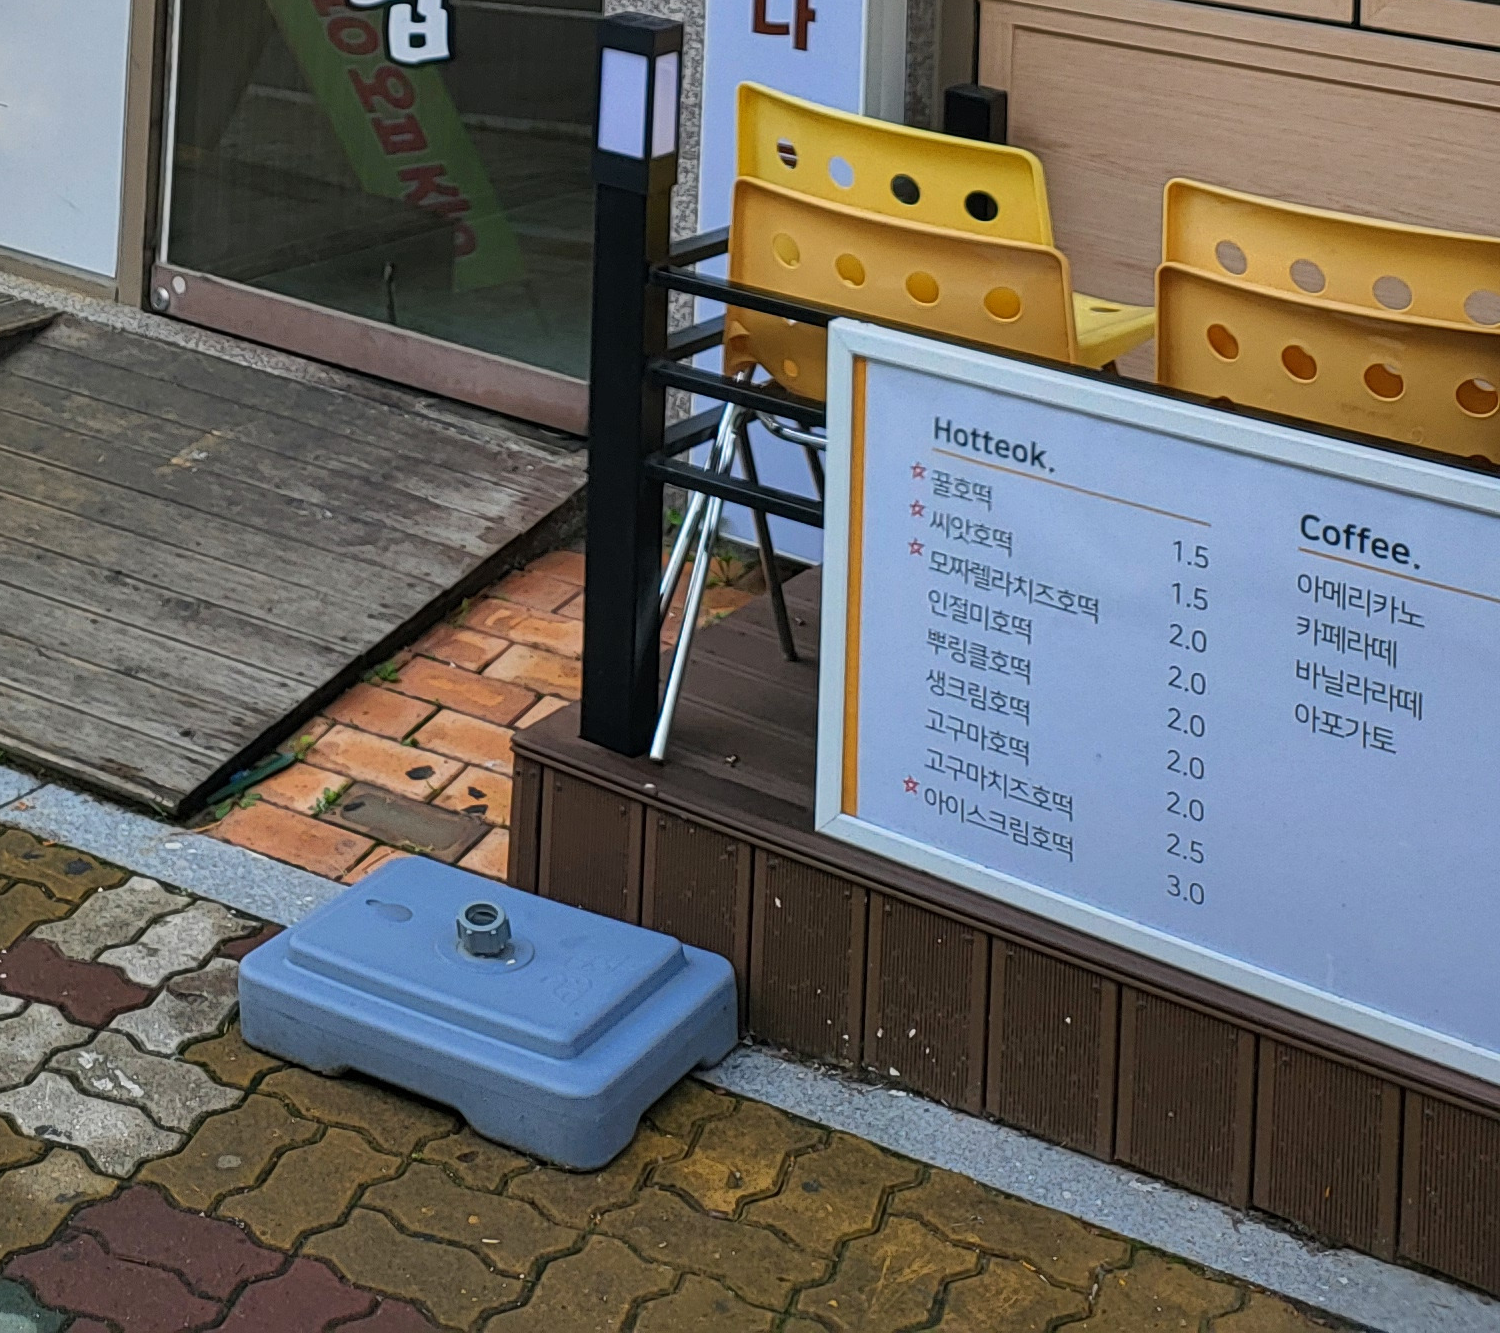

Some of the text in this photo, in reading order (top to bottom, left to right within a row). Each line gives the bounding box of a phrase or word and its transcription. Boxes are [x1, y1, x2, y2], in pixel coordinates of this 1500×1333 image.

[933, 415, 1057, 475] Hotteok.
[929, 509, 1210, 612] 씨앗호떡 1.5
[930, 469, 1210, 571] 꿀호떡 1.5
[1298, 512, 1424, 571] Coffee.
[927, 588, 1208, 696] 인절미호떡 2.0
[928, 549, 1208, 654] 모짜렐라치즈호떡 2.0
[1295, 572, 1426, 630] 아메리카노
[1295, 614, 1399, 669] 카페라떼
[925, 668, 1206, 780] 생크림호떡 2.0
[926, 628, 1207, 738] 뿌링클호떡 2.0
[1293, 657, 1424, 721] 바닐라라떼
[1293, 701, 1399, 756] 아포가토
[923, 746, 1206, 865] 고구마치즈호떡 2.5
[924, 707, 1206, 823] 고구마호떡 2.0
[923, 786, 1206, 907] 아이스크림호떡 3.0
